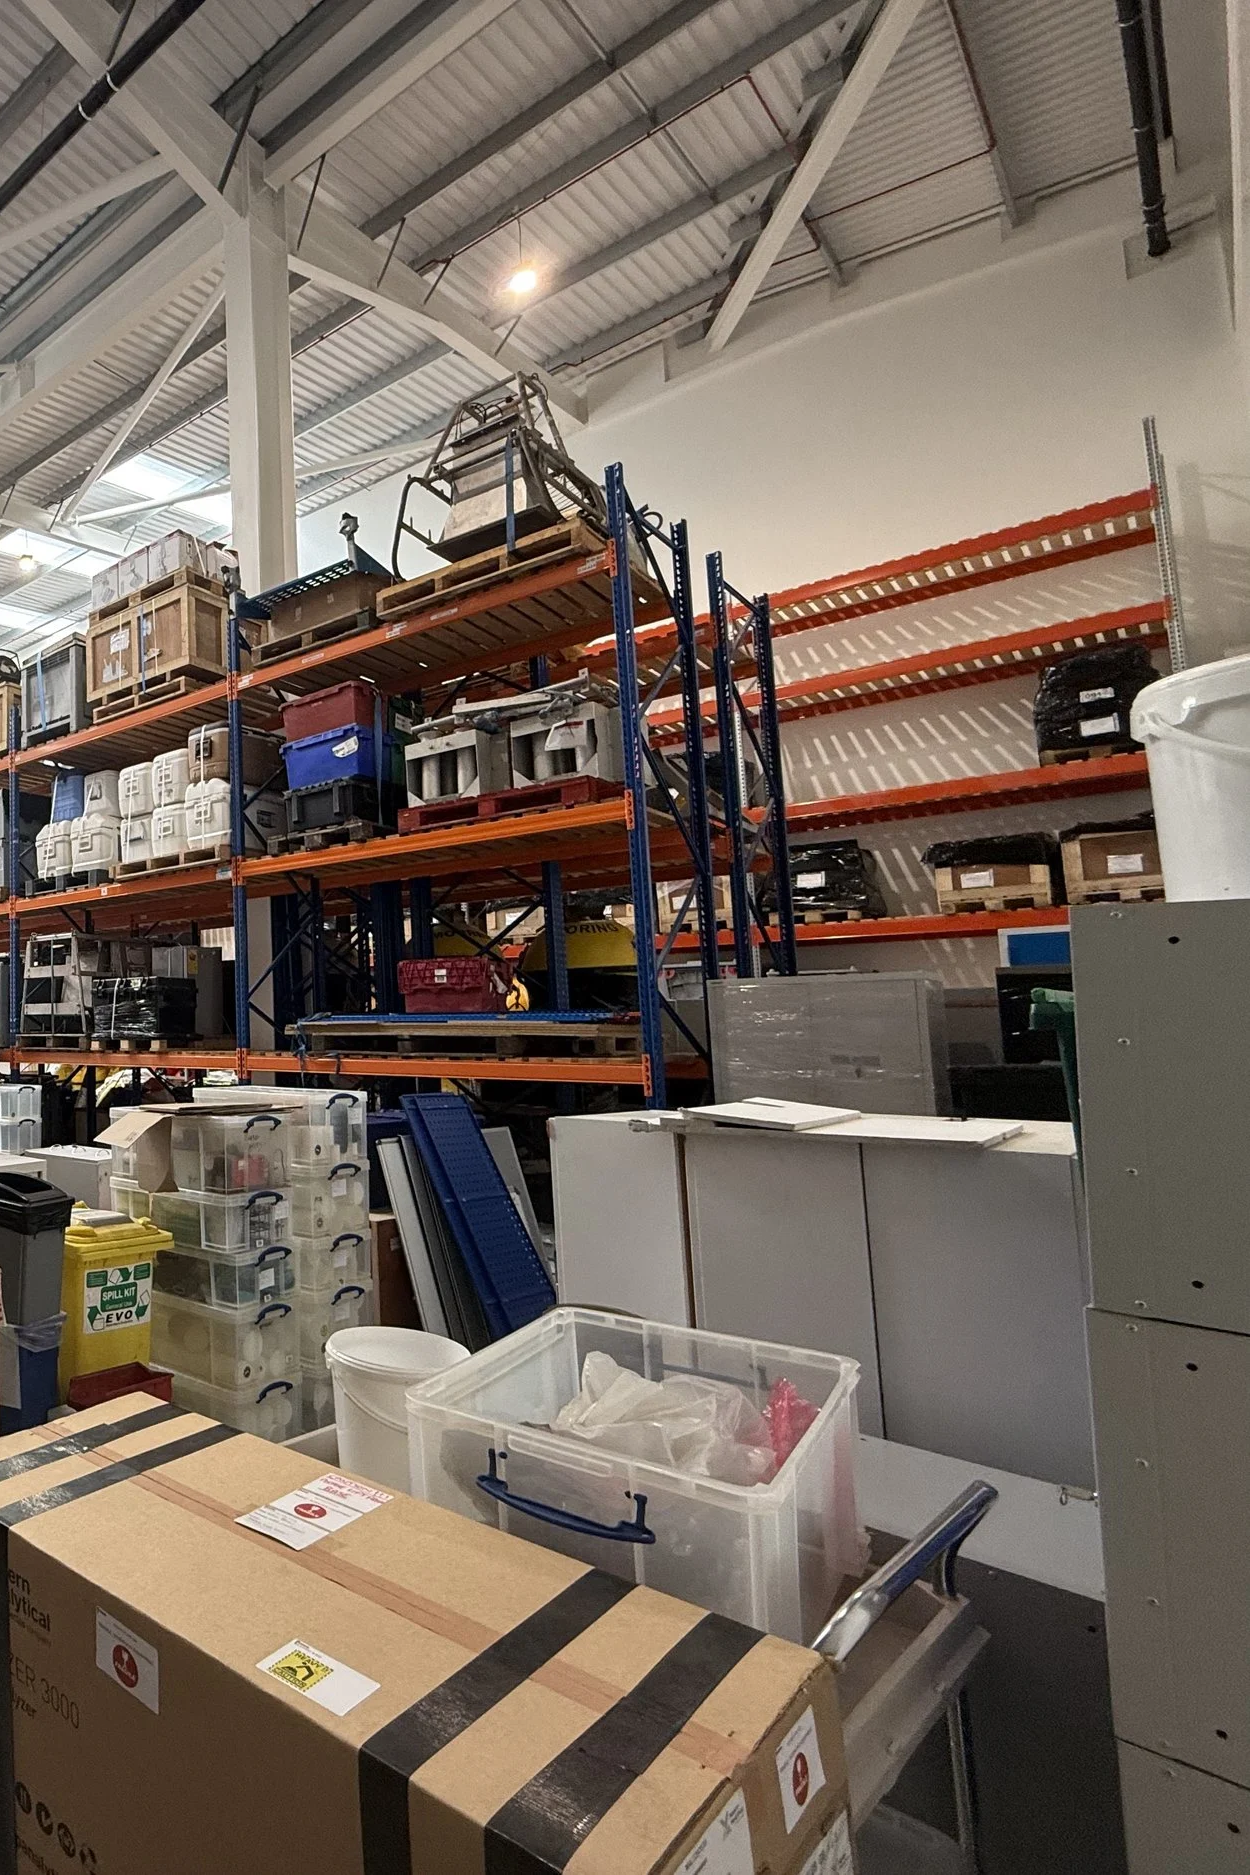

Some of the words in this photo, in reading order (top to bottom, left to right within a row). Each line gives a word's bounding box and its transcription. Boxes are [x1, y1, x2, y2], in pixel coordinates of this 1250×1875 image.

[566, 921, 619, 934] ORING
[103, 1291, 123, 1301] SPILL
[125, 1287, 136, 1296] KIT
[106, 1310, 133, 1323] EVO
[41, 1678, 79, 1729] 3000
